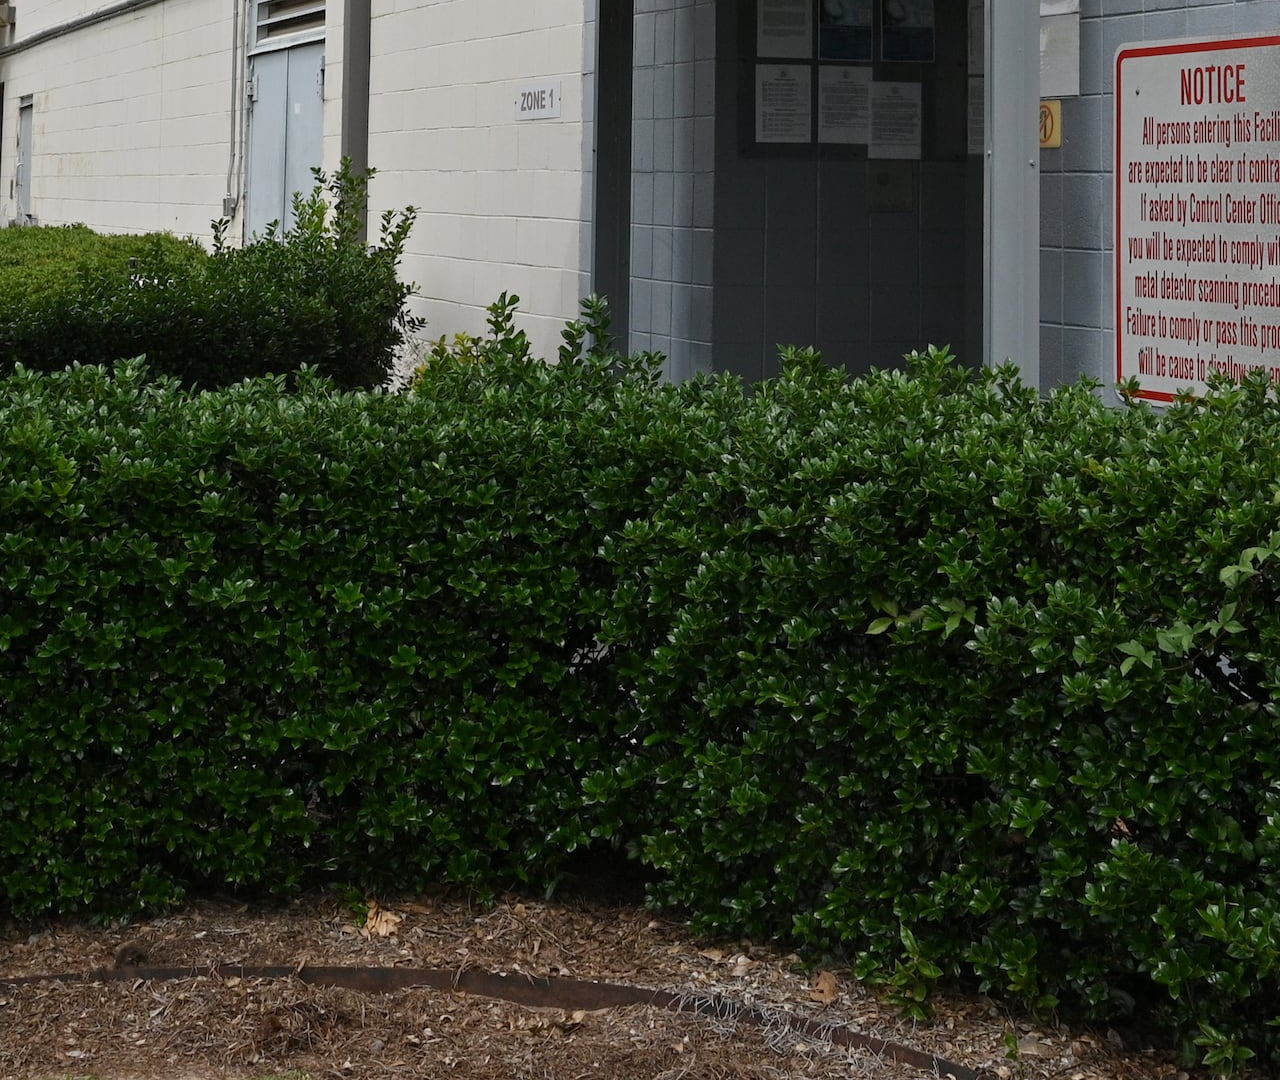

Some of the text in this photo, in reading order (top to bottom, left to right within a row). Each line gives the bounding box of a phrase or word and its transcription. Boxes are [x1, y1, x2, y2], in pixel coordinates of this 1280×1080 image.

[520, 88, 554, 112] ZONE 1
[1180, 64, 1246, 105] NOTICE
[1142, 116, 1154, 146] All
[1156, 120, 1191, 150] persons
[1193, 113, 1231, 149] entering
[1234, 111, 1251, 143] this
[1128, 159, 1142, 184] are
[1145, 153, 1184, 189] expected
[1186, 155, 1194, 184] to
[1197, 153, 1208, 184] be
[1211, 153, 1234, 184] clear
[1237, 152, 1246, 184] of
[1140, 192, 1147, 221] If
[1149, 192, 1174, 222] asked
[1176, 192, 1187, 227] by
[1189, 192, 1222, 223] Control
[1225, 193, 1256, 224] Center
[1128, 235, 1143, 264] you
[1145, 231, 1161, 261] will
[1163, 231, 1174, 261] be
[1176, 233, 1216, 267] expected
[1219, 234, 1228, 264] to
[1231, 234, 1264, 271] comply
[1134, 269, 1158, 299] metal
[1160, 270, 1197, 302] detector
[1198, 274, 1239, 310] scanning
[1126, 306, 1156, 337] Failure
[1158, 309, 1167, 339] to
[1169, 311, 1201, 347] comply
[1203, 319, 1213, 343] or
[1215, 319, 1237, 348] pass
[1240, 315, 1258, 347] this
[1138, 347, 1153, 376] will
[1155, 348, 1166, 377] be
[1169, 355, 1194, 381] cause
[1197, 353, 1205, 382] to
